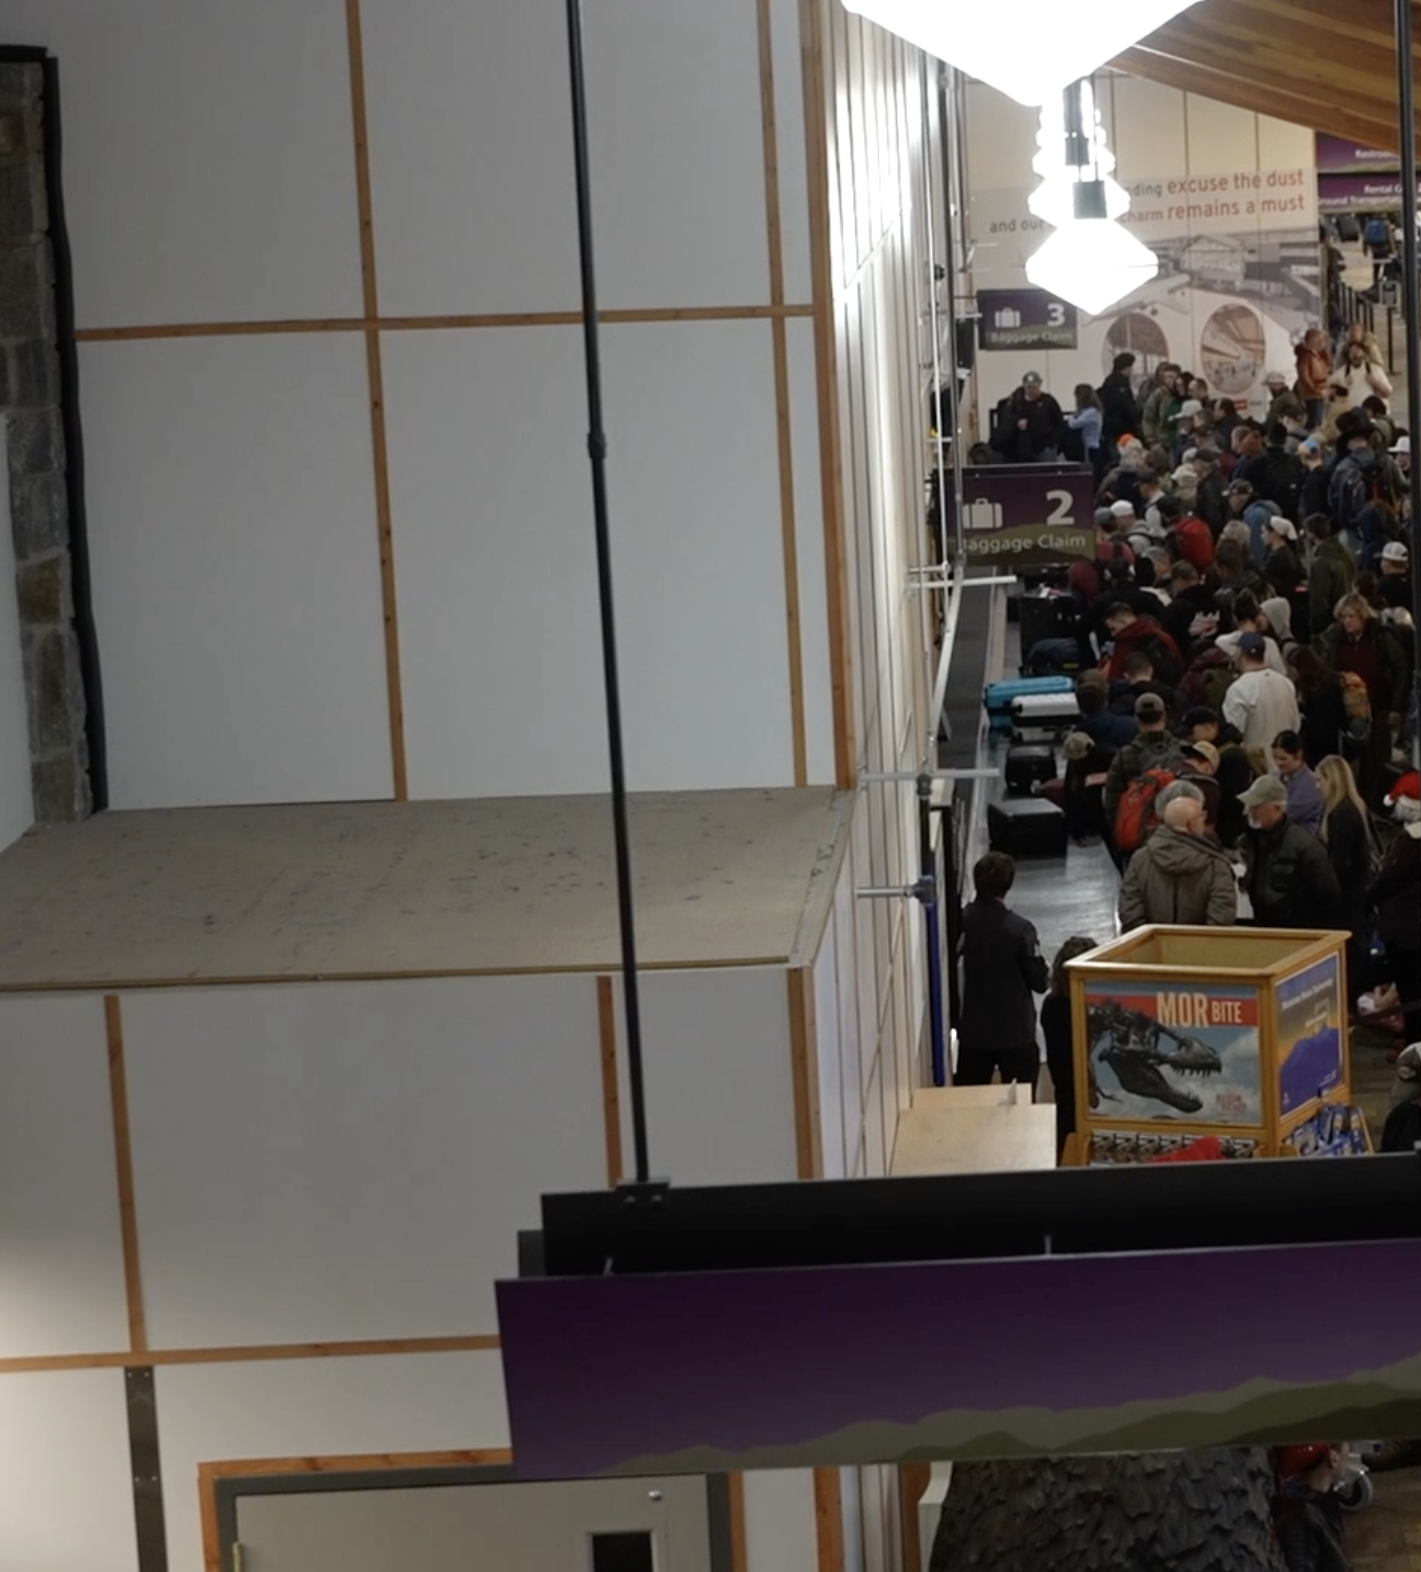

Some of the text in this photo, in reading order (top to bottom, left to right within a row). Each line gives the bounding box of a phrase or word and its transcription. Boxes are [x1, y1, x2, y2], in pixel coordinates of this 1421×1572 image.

[1167, 176, 1228, 195] excuse
[1234, 172, 1262, 190] the
[1267, 169, 1304, 188] dust
[1364, 184, 1393, 194] Rental
[1318, 195, 1348, 205] round
[990, 219, 1016, 233] and
[1168, 200, 1240, 219] remains
[1246, 201, 1256, 214] a
[1262, 195, 1305, 212] must
[1047, 303, 1066, 327] 3
[990, 331, 1072, 344] Baggage Claim
[1046, 490, 1075, 525] 2
[1037, 534, 1086, 549] Claim
[1156, 992, 1242, 1028] MOR BITE
